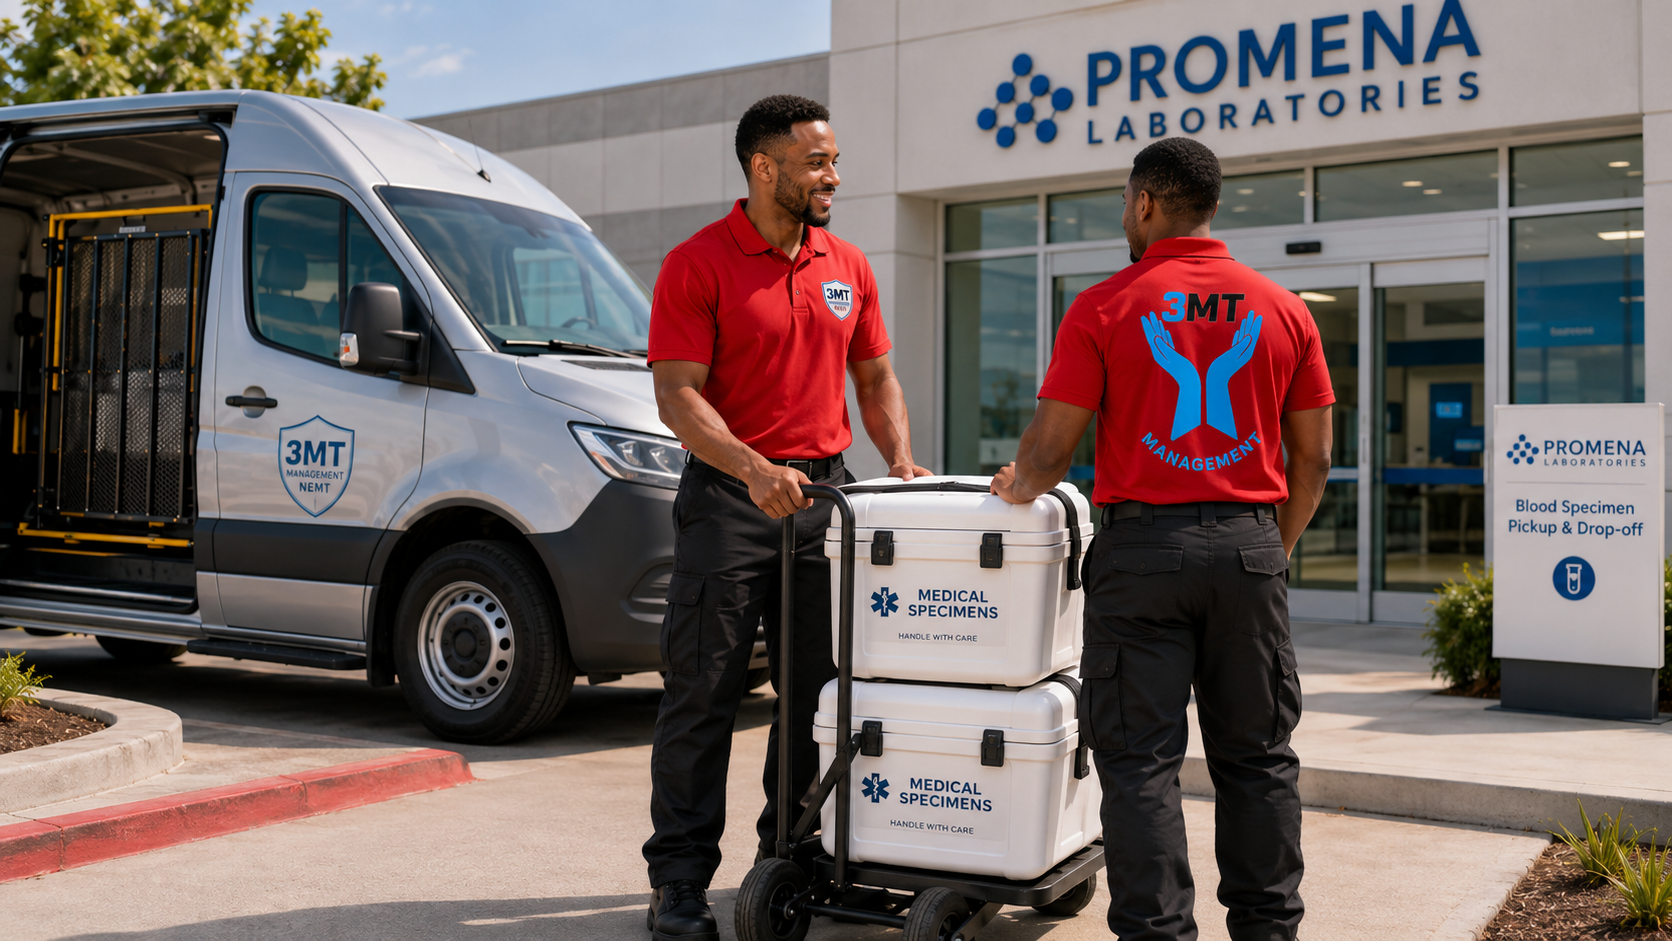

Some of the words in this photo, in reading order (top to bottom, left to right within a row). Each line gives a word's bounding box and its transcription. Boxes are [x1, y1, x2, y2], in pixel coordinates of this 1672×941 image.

[1087, 0, 1481, 107] PROMENA
[1087, 71, 1480, 145] LABORATORIES
[826, 288, 850, 301] 3MT
[1161, 291, 1245, 323] 3MT
[285, 439, 346, 467] 3MT
[1141, 431, 1261, 471] MANAGEMENT
[1544, 440, 1646, 456] PROMENA
[1544, 458, 1646, 467] LABORATORIES
[286, 469, 344, 480] MANAGEMENT
[299, 482, 331, 494] NEMT
[1516, 499, 1557, 513] Blood
[1561, 500, 1635, 517] Specimen
[1508, 519, 1557, 537] Pickup
[1561, 520, 1573, 534] &
[1577, 521, 1643, 539] Drop-off
[918, 588, 989, 603] MEDICAL
[908, 604, 998, 619] SPECIMENS
[898, 632, 931, 641] HANDLE
[955, 634, 978, 642] CARE
[910, 777, 982, 796] MEDICAL
[899, 792, 993, 812] SPECIMENS
[890, 819, 924, 830] HANDLE
[926, 823, 949, 832] WITH
[950, 825, 974, 834] CARE
